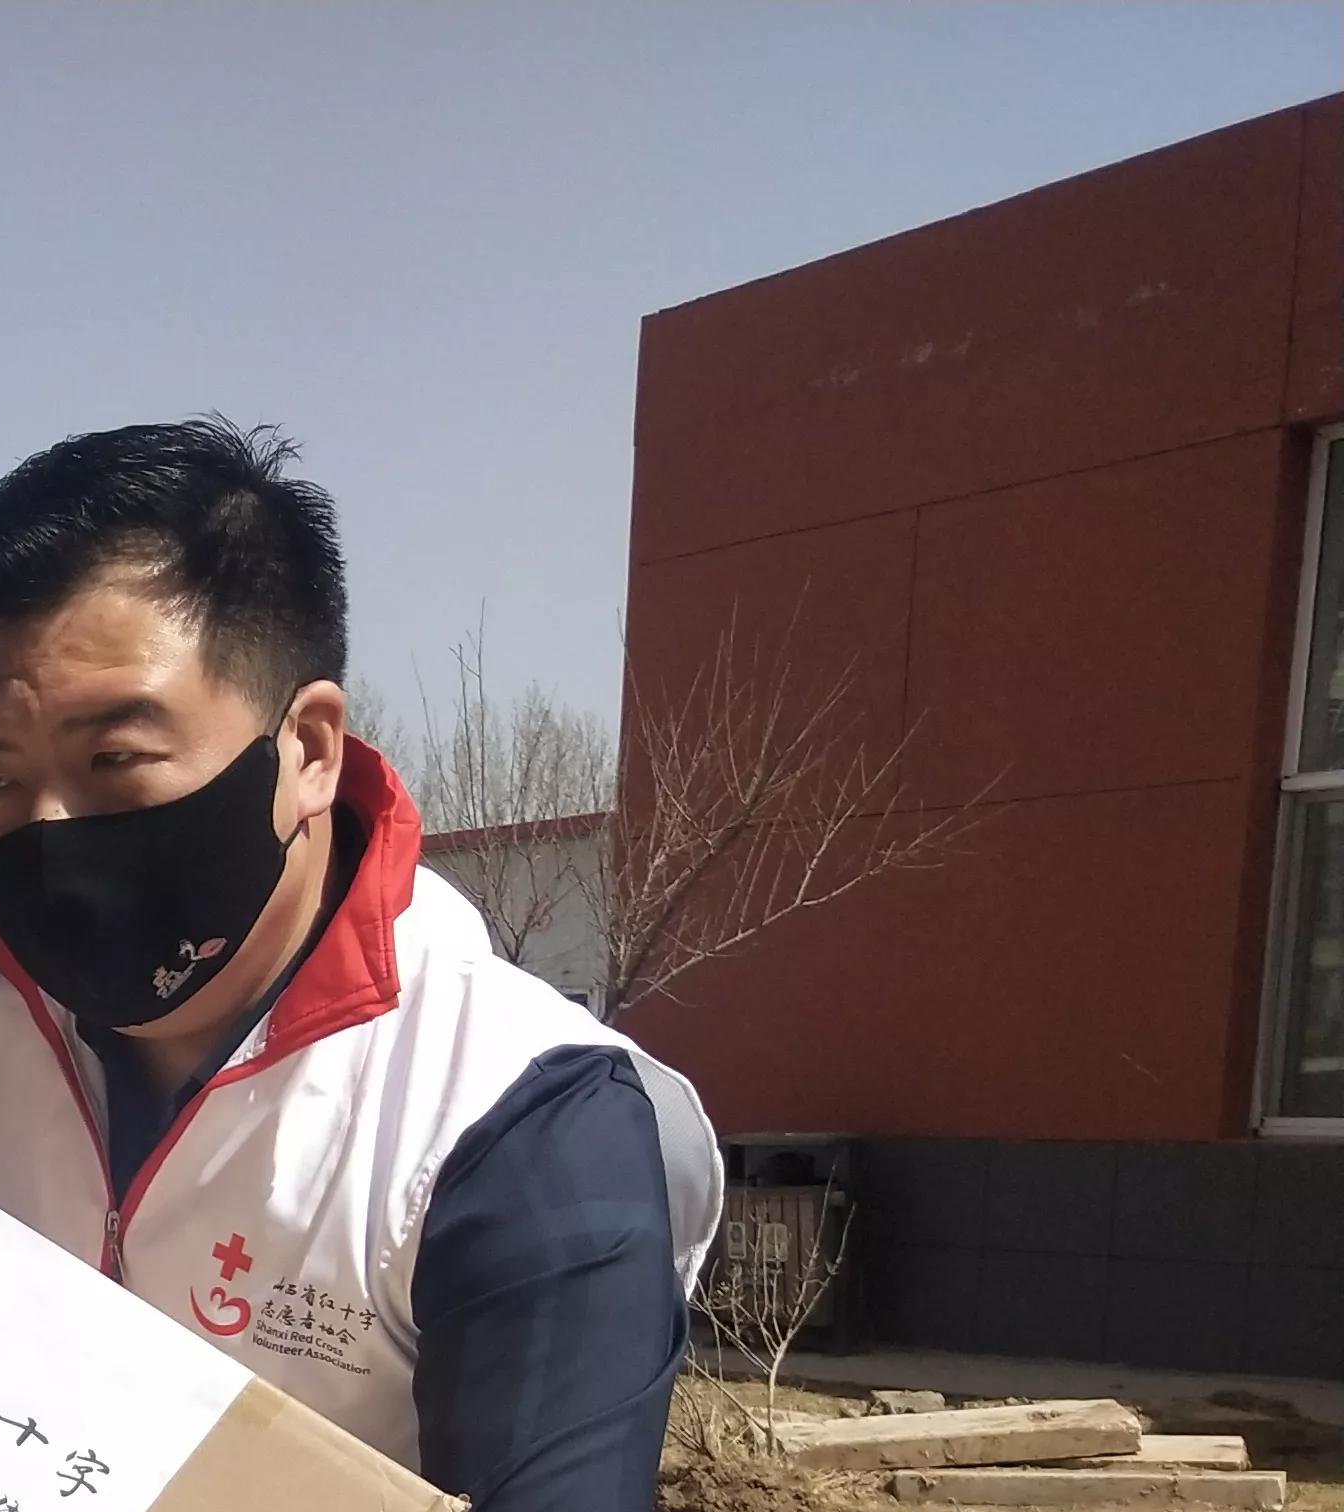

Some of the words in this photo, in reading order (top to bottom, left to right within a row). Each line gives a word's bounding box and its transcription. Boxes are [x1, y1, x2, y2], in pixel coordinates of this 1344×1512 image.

[252, 1332, 303, 1356] Volunteer
[304, 1347, 372, 1375] Association
[255, 1319, 288, 1341] Shanxi
[291, 1330, 314, 1344] Red
[315, 1337, 344, 1357] Cross
